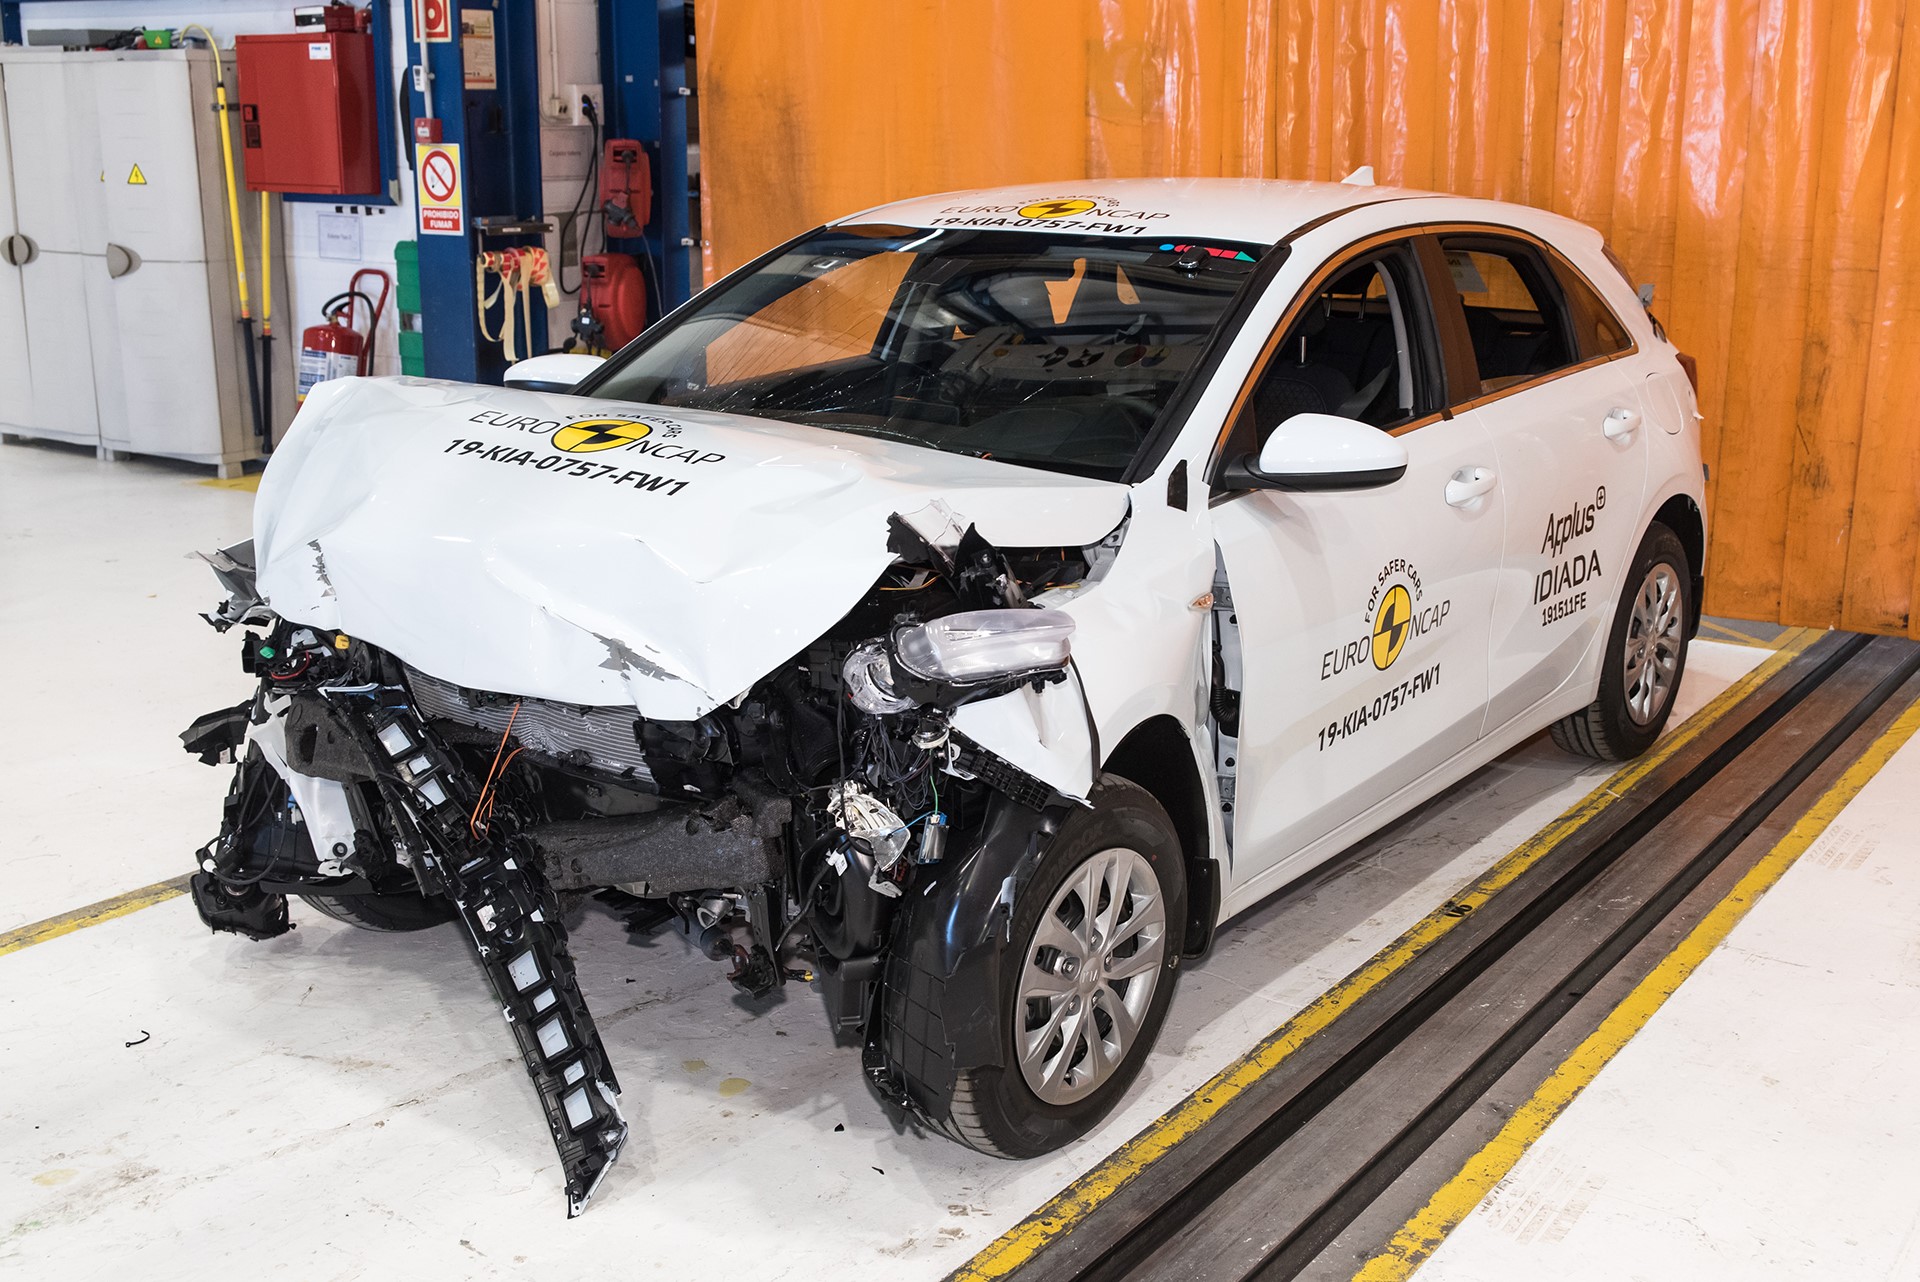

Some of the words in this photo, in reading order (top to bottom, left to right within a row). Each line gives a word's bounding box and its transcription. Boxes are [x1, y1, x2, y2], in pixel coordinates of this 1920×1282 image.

[423, 209, 459, 219] PROHIBIDO
[430, 219, 453, 228] FUMAR
[929, 217, 1148, 235] 19-KIA-0757-FW1
[939, 204, 1019, 214] EURO
[1085, 208, 1170, 221] NCAP
[468, 410, 561, 435] EURO
[625, 440, 726, 465] NCAP
[443, 438, 691, 496] 19-KIA-0757-FW1
[1364, 585, 1380, 624] FOR
[1378, 558, 1405, 586] SAFER
[1407, 563, 1423, 602] CARS
[1533, 549, 1602, 605] IDIADA
[1542, 591, 1587, 627] 191511FE
[1321, 635, 1371, 681] EURO
[1409, 599, 1451, 640] NCAP
[1318, 662, 1441, 751] 19-KIA-0757-FW1
